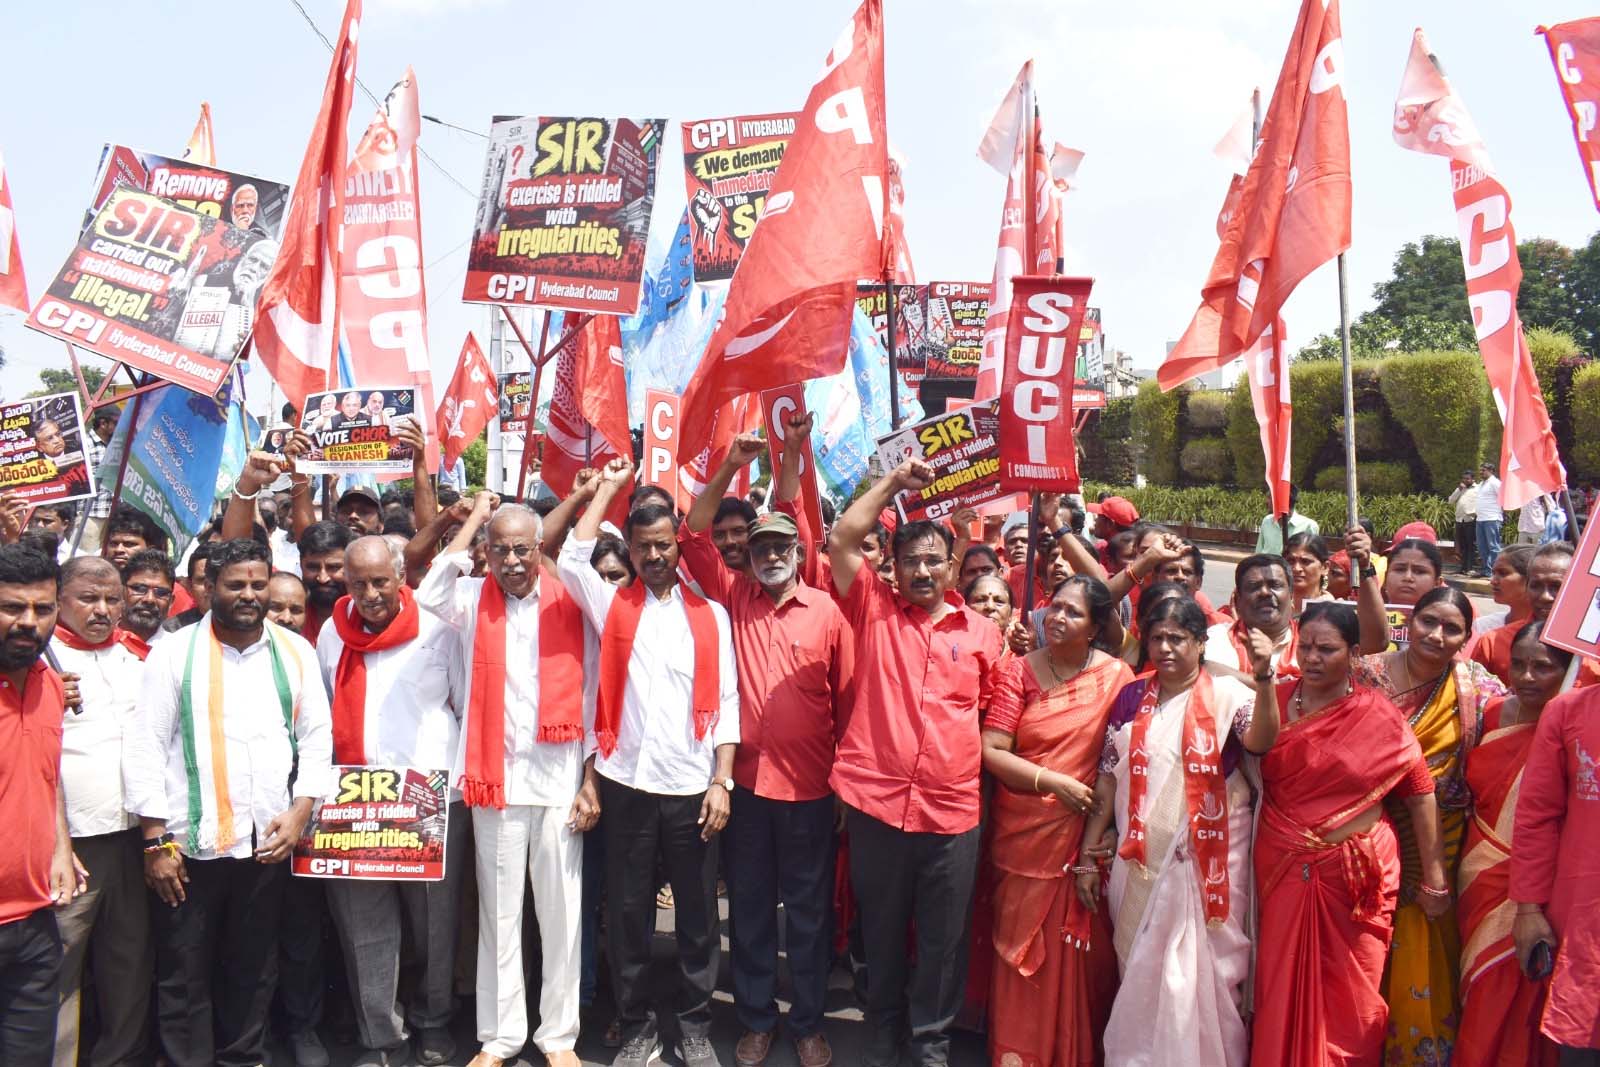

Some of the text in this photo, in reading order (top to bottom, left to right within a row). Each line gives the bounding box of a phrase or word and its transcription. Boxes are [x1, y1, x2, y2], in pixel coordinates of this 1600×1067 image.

[691, 118, 796, 149] CPI HYDERABAD
[530, 120, 604, 176] SIR
[704, 157, 729, 175] We
[152, 168, 228, 198] Remove
[510, 178, 622, 207] exercise is riddled
[724, 194, 749, 207] to the
[545, 205, 577, 225] with
[732, 196, 765, 239] SI
[104, 198, 198, 258] SIR
[496, 220, 622, 260] irregularities,
[91, 237, 174, 276] carried out
[80, 255, 164, 292] nationwide
[487, 274, 618, 302] CPI Hyderabad Council
[936, 284, 991, 296] CPI Hyder
[186, 312, 221, 327] ILLEGAL
[36, 300, 223, 384] CPI Hyderabad Council
[906, 372, 927, 382] Coun
[1014, 292, 1074, 464] SUCI
[508, 421, 526, 430] CPI
[919, 415, 973, 456] SIR
[315, 426, 389, 447] VOTE CHOR
[329, 444, 372, 453] RESIGNATION
[329, 450, 384, 461] GYANESH
[927, 434, 996, 470] ercise is riddled
[947, 460, 970, 474] with
[1014, 464, 1060, 480] COMMUNIST
[920, 457, 1000, 499] irregularitie
[44, 484, 66, 494] Council
[1189, 762, 1218, 776] CPI
[336, 771, 398, 804] SIR
[321, 804, 416, 820] exercise is riddled
[352, 821, 379, 832] with
[1197, 829, 1224, 841] CPI
[314, 828, 424, 851] irregularities,
[310, 858, 425, 875] CPI Hyderabad Council
